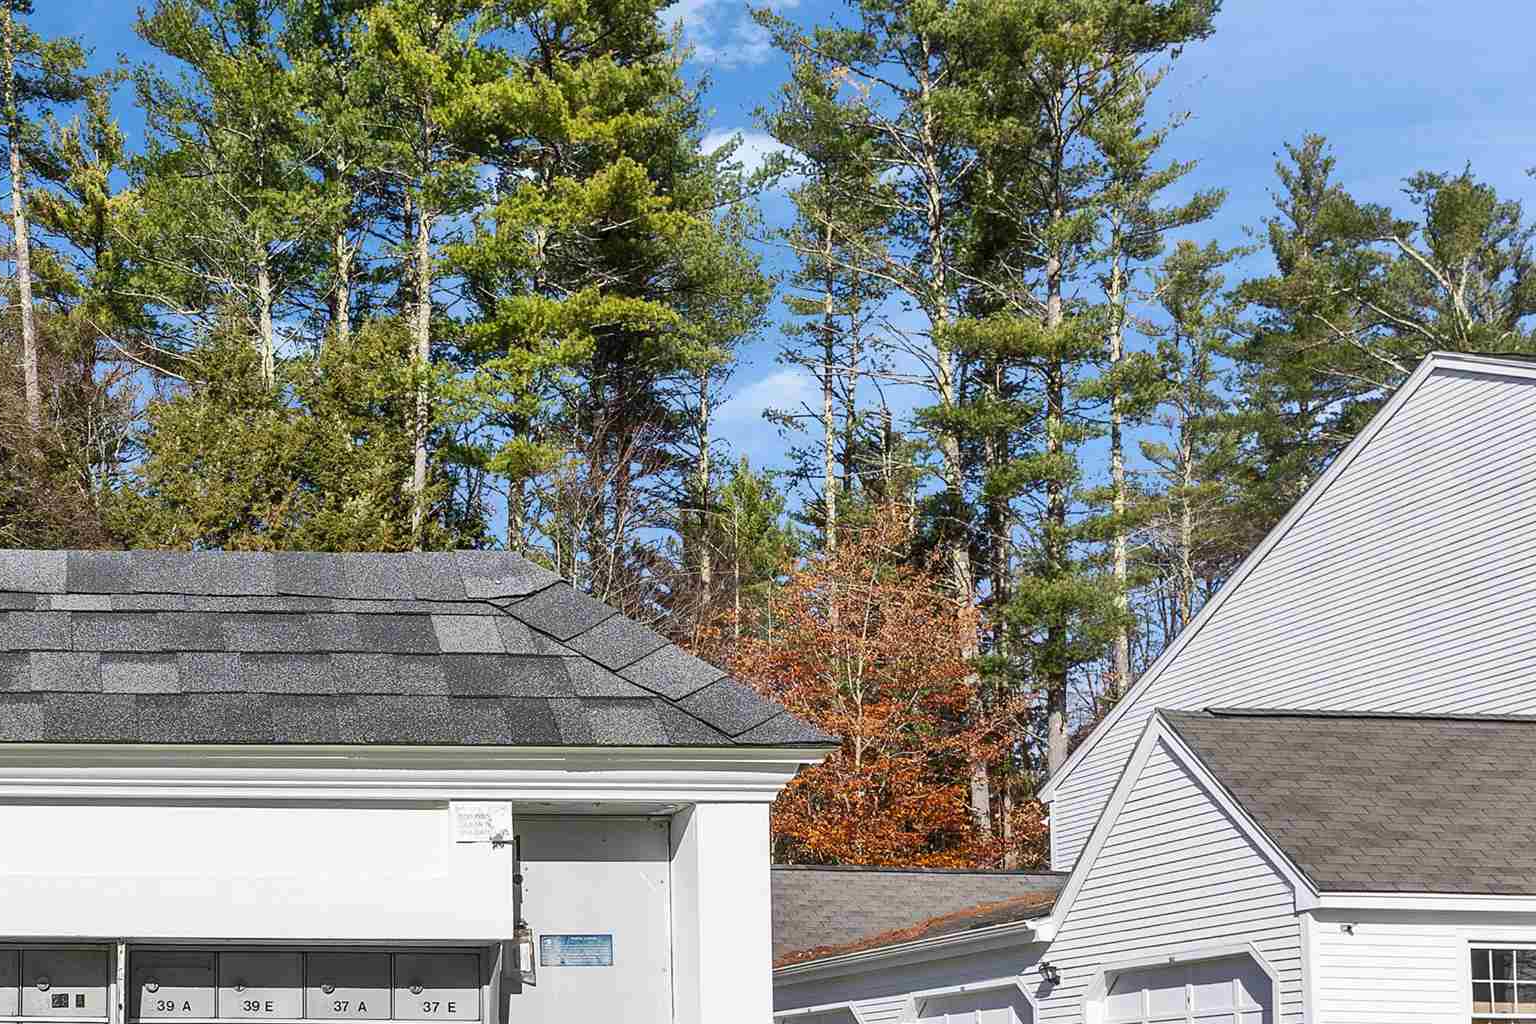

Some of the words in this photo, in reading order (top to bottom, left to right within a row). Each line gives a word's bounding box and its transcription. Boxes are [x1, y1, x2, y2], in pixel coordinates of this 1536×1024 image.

[156, 999, 175, 1012] 39
[182, 1000, 192, 1012] A
[242, 999, 261, 1012] 39
[264, 1000, 274, 1013] E
[333, 1000, 350, 1013] 37
[357, 1000, 368, 1013] A
[422, 1001, 441, 1014] 37
[447, 1001, 457, 1014] E
